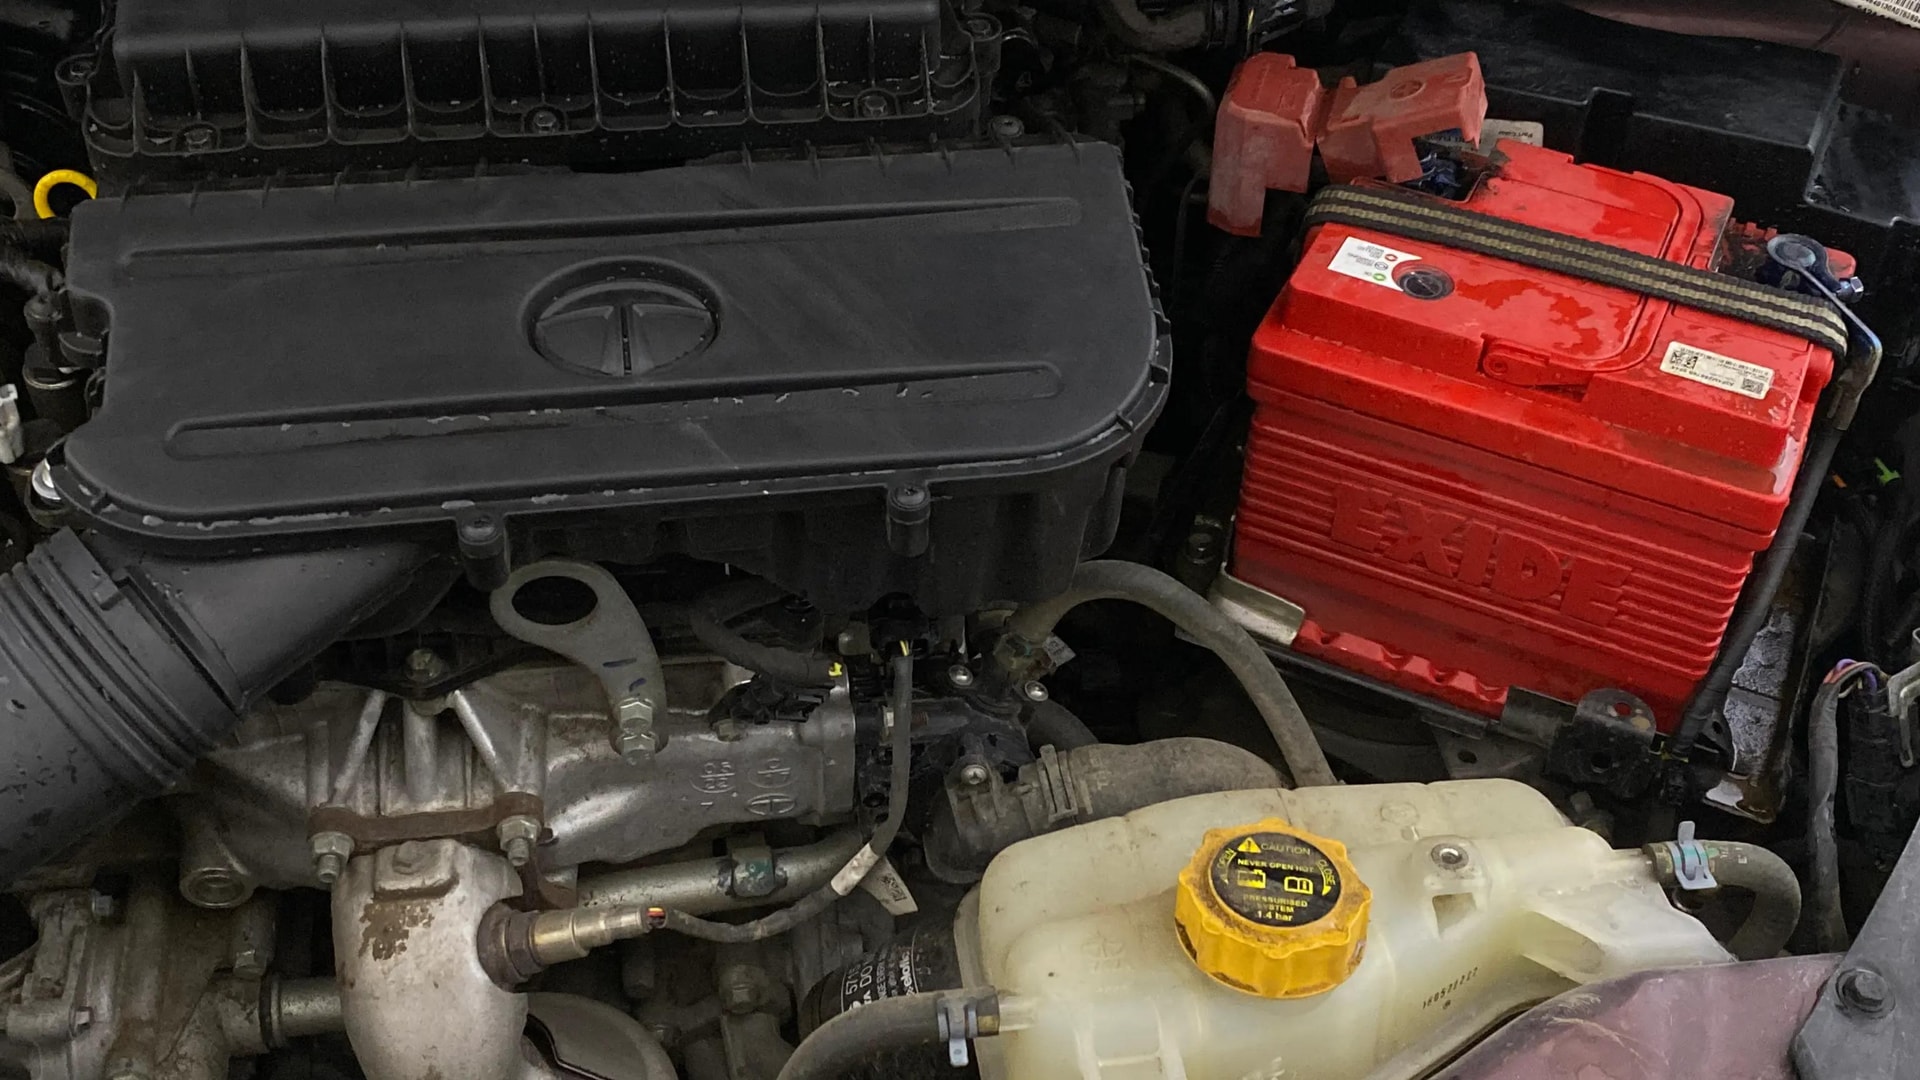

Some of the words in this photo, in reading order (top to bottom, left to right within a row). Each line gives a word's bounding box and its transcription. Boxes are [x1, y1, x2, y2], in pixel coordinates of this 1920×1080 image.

[1330, 480, 1632, 627] EXIDE
[1261, 842, 1311, 855] CAUTION
[1217, 848, 1235, 869] OPEN
[1238, 859, 1267, 868] NEVER
[1269, 861, 1294, 870] OPEN
[1294, 865, 1314, 873] HOT
[1318, 859, 1336, 886] CLOSE
[1257, 911, 1272, 919] 1.4
[1275, 912, 1294, 922] bar
